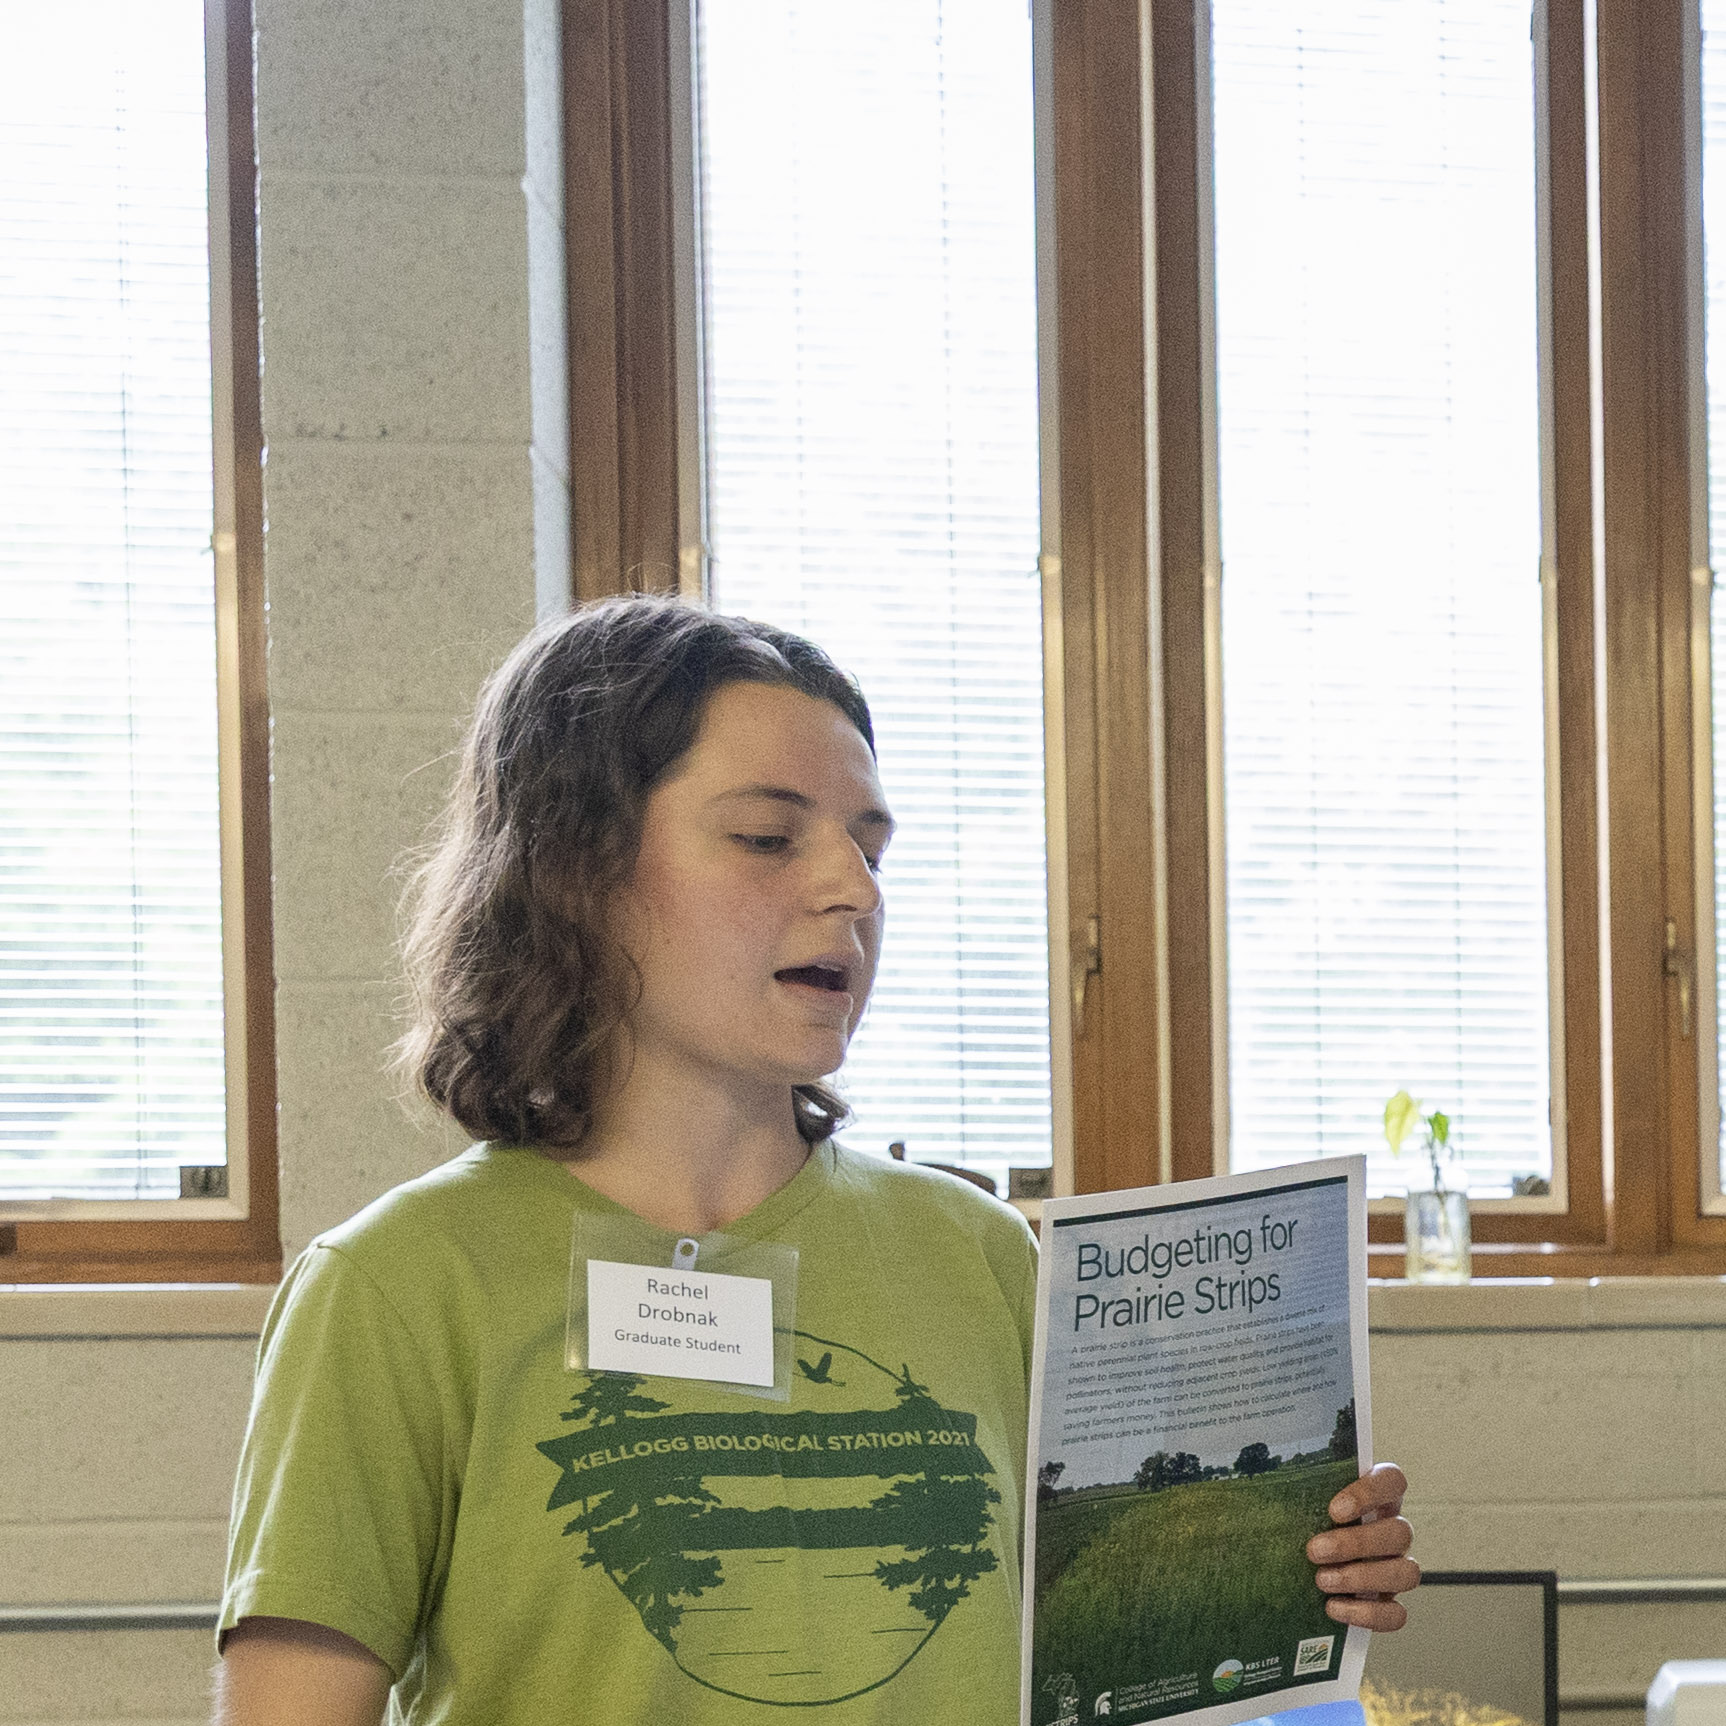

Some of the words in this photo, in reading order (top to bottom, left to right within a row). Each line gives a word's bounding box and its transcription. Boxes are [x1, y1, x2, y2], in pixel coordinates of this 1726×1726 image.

[1077, 1226, 1252, 1282] Budgeting
[1259, 1214, 1298, 1252] for
[648, 1278, 708, 1300] Rachel
[1074, 1283, 1185, 1332] Prairie
[1194, 1270, 1282, 1314] Strips
[638, 1303, 718, 1327] Drobnak
[614, 1328, 681, 1348] Graduate
[685, 1336, 741, 1354] Student
[572, 1436, 689, 1473] KELLOGG
[694, 1433, 824, 1453] BIOLOGICAL
[828, 1429, 922, 1451] STATION
[926, 1429, 971, 1447] 2021
[1245, 1659, 1260, 1671] KBS
[1118, 1694, 1133, 1704] and
[1134, 1688, 1161, 1701] Natural
[1161, 1681, 1199, 1695] Resources
[1119, 1684, 1147, 1696] College
[1157, 1672, 1198, 1686] Agriculture
[1118, 1699, 1148, 1712] MICHIGAN
[1149, 1695, 1165, 1706] STATE
[1165, 1688, 1199, 1702] UNIVERSITY
